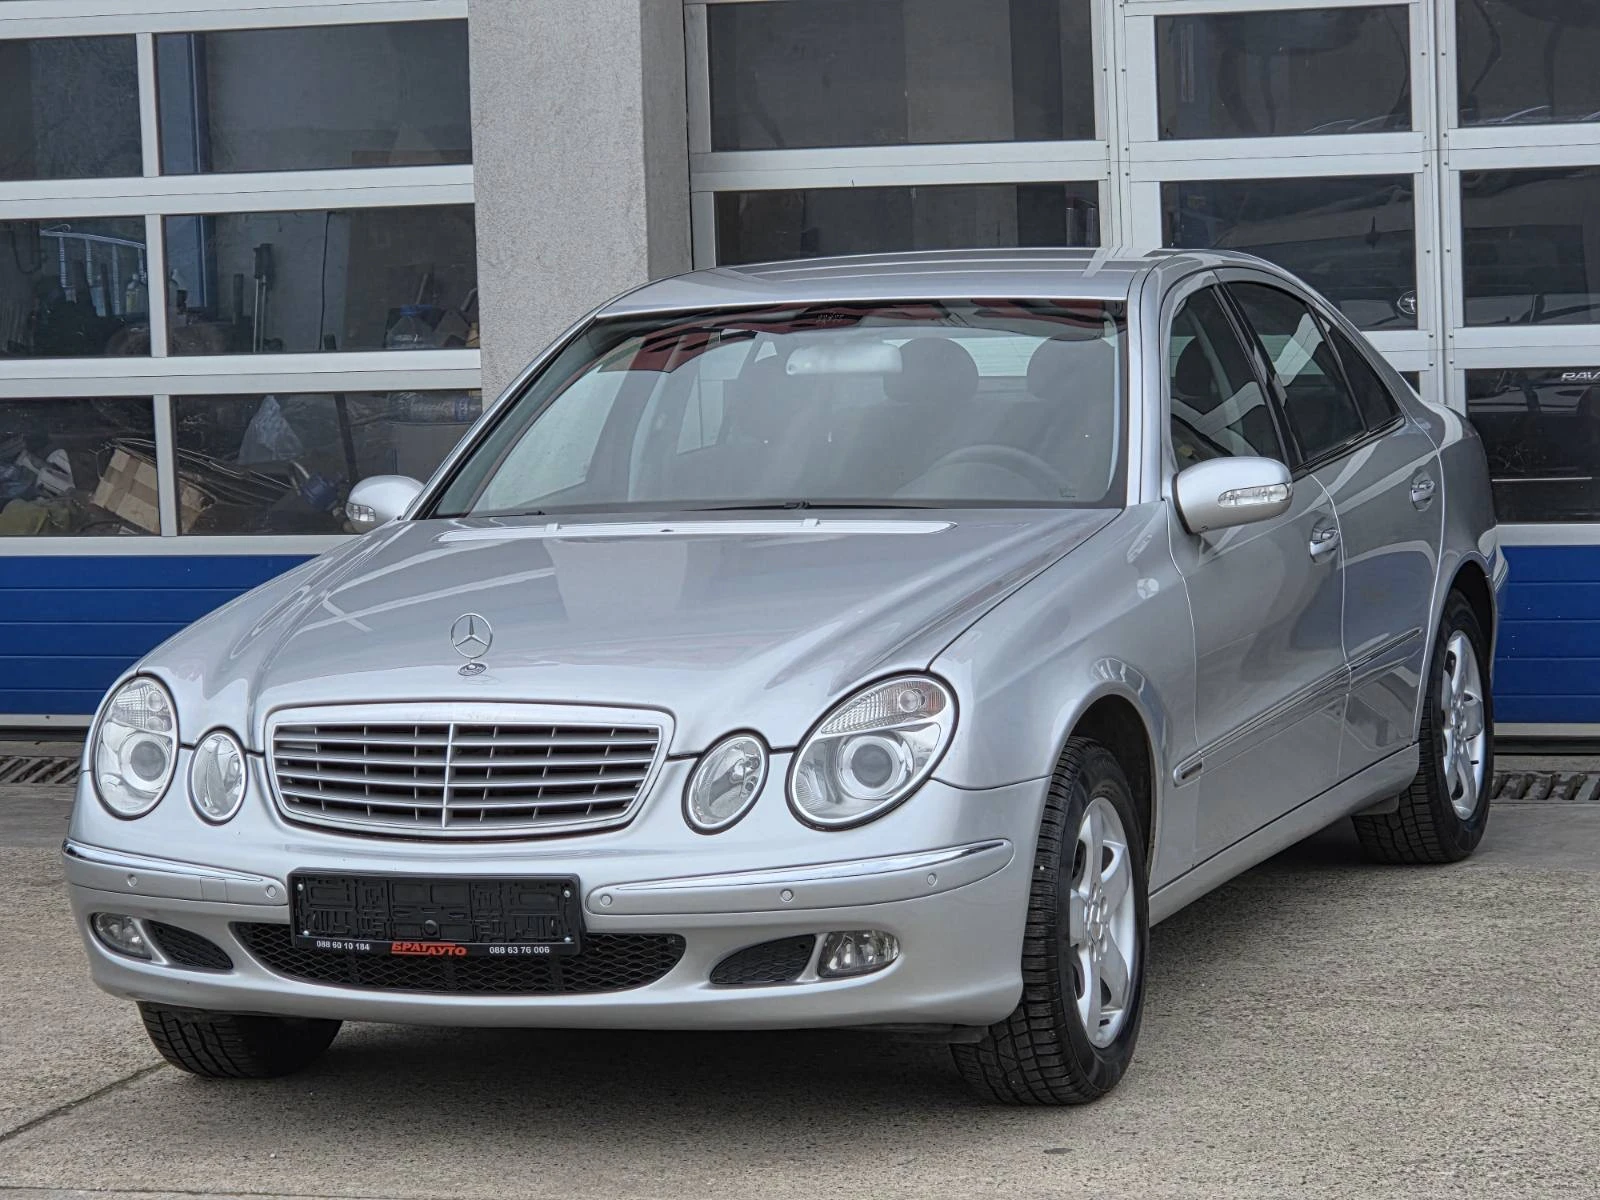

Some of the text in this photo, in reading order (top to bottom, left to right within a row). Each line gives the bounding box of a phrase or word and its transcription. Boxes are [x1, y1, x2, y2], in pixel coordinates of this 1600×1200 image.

[316, 940, 331, 948] 088
[343, 942, 354, 950] 10
[355, 943, 370, 951] 184
[489, 946, 550, 954] 088 63 76 006
